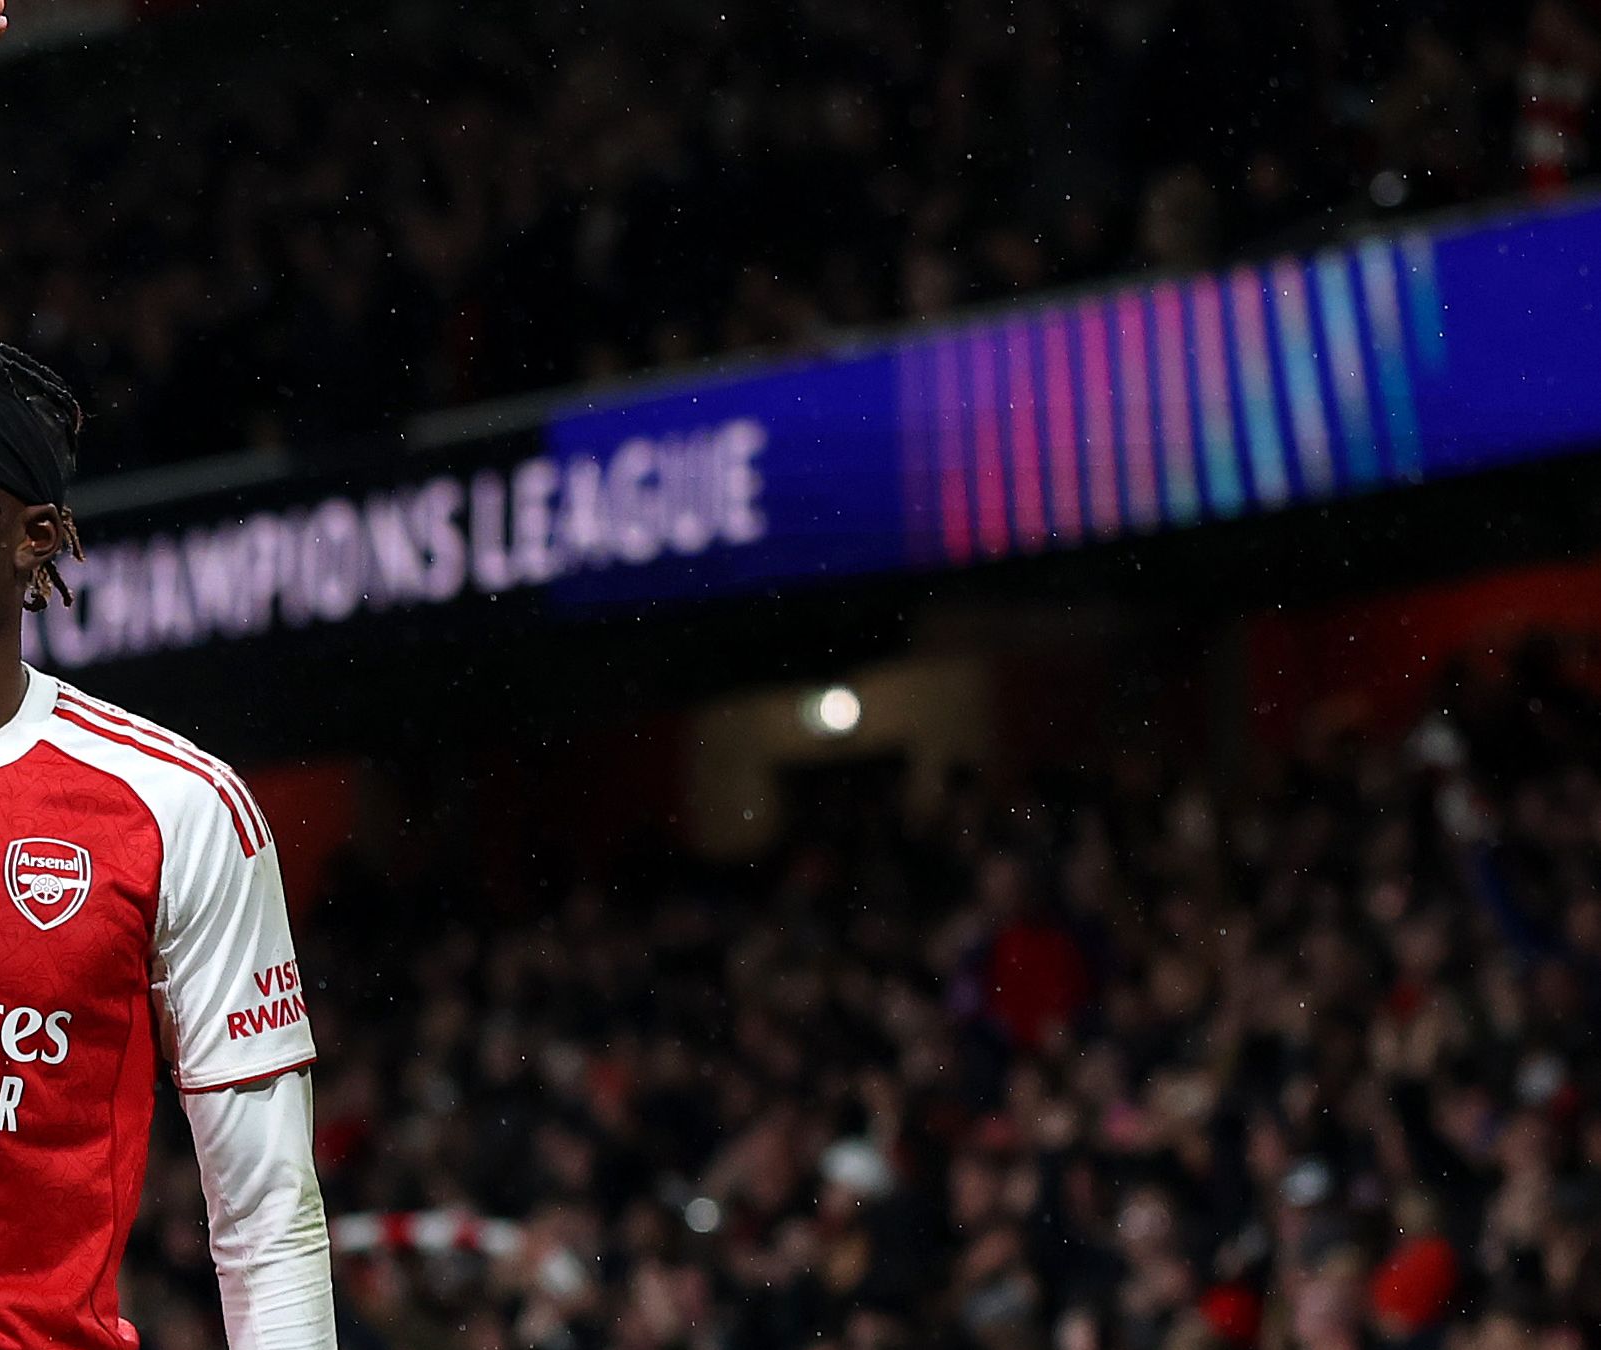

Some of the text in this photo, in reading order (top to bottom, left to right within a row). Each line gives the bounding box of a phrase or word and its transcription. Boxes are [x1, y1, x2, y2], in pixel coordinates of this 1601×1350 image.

[47, 418, 768, 667] CHAMPIONS LEAGUE
[18, 851, 79, 872] Arsenal
